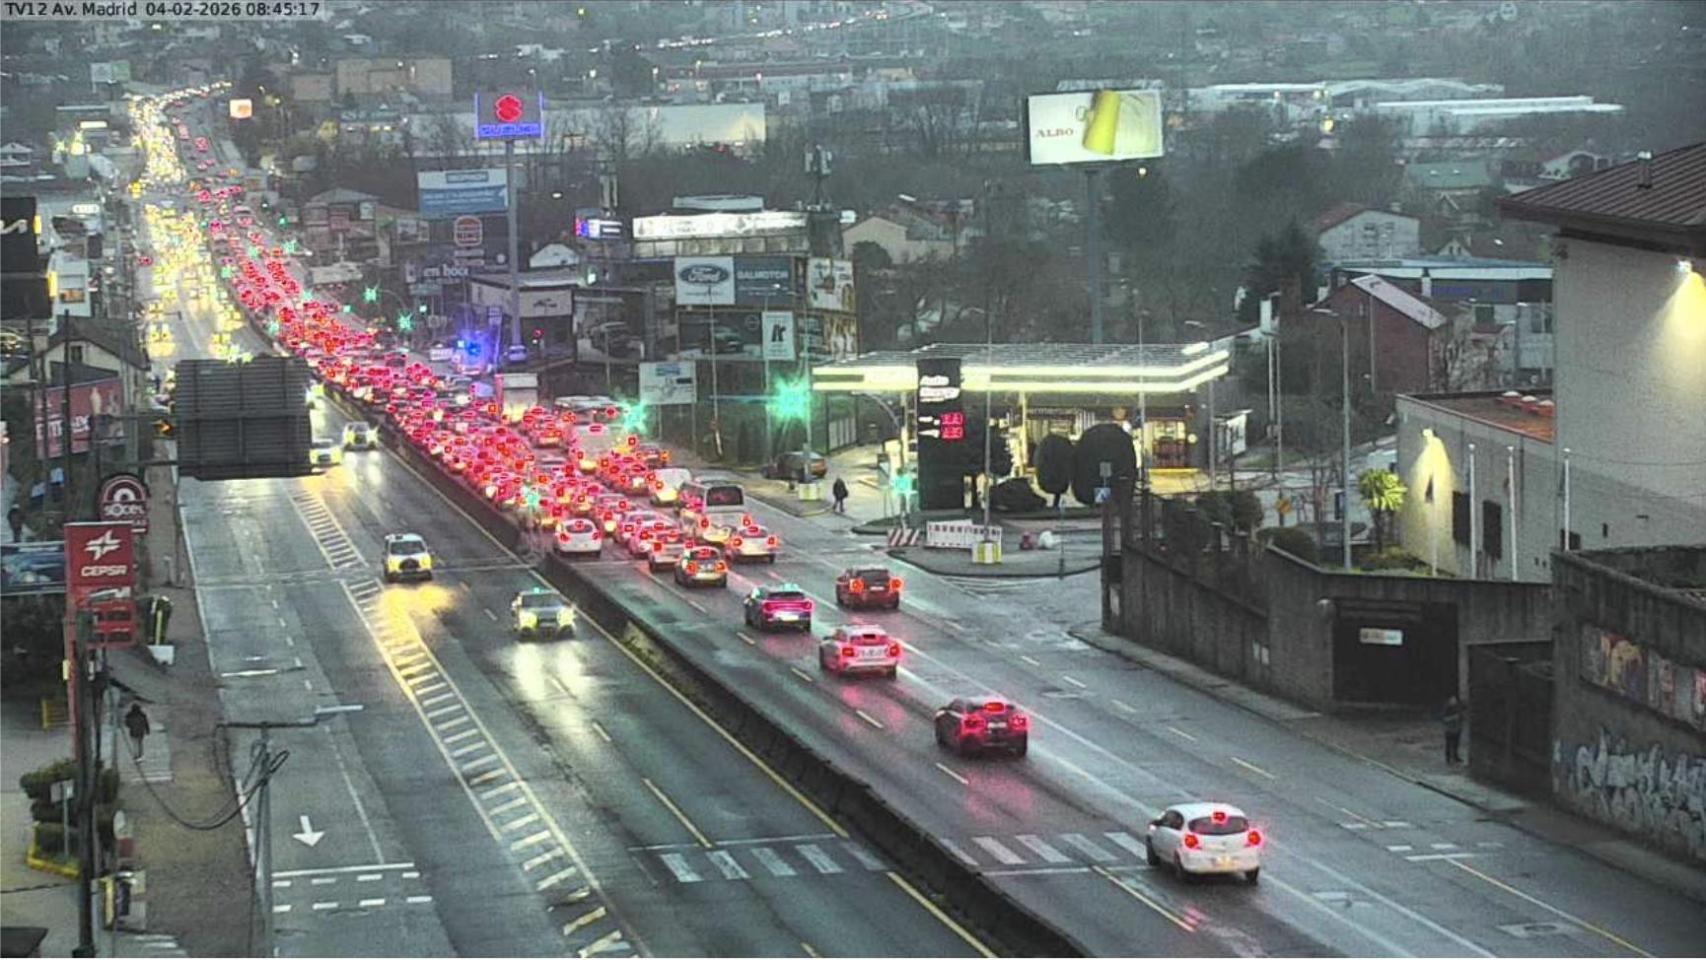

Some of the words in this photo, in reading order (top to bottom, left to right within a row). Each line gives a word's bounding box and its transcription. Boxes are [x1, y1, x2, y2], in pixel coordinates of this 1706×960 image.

[1036, 127, 1074, 138] ALBO
[687, 264, 722, 283] Ford
[81, 565, 128, 577] CEPSA
